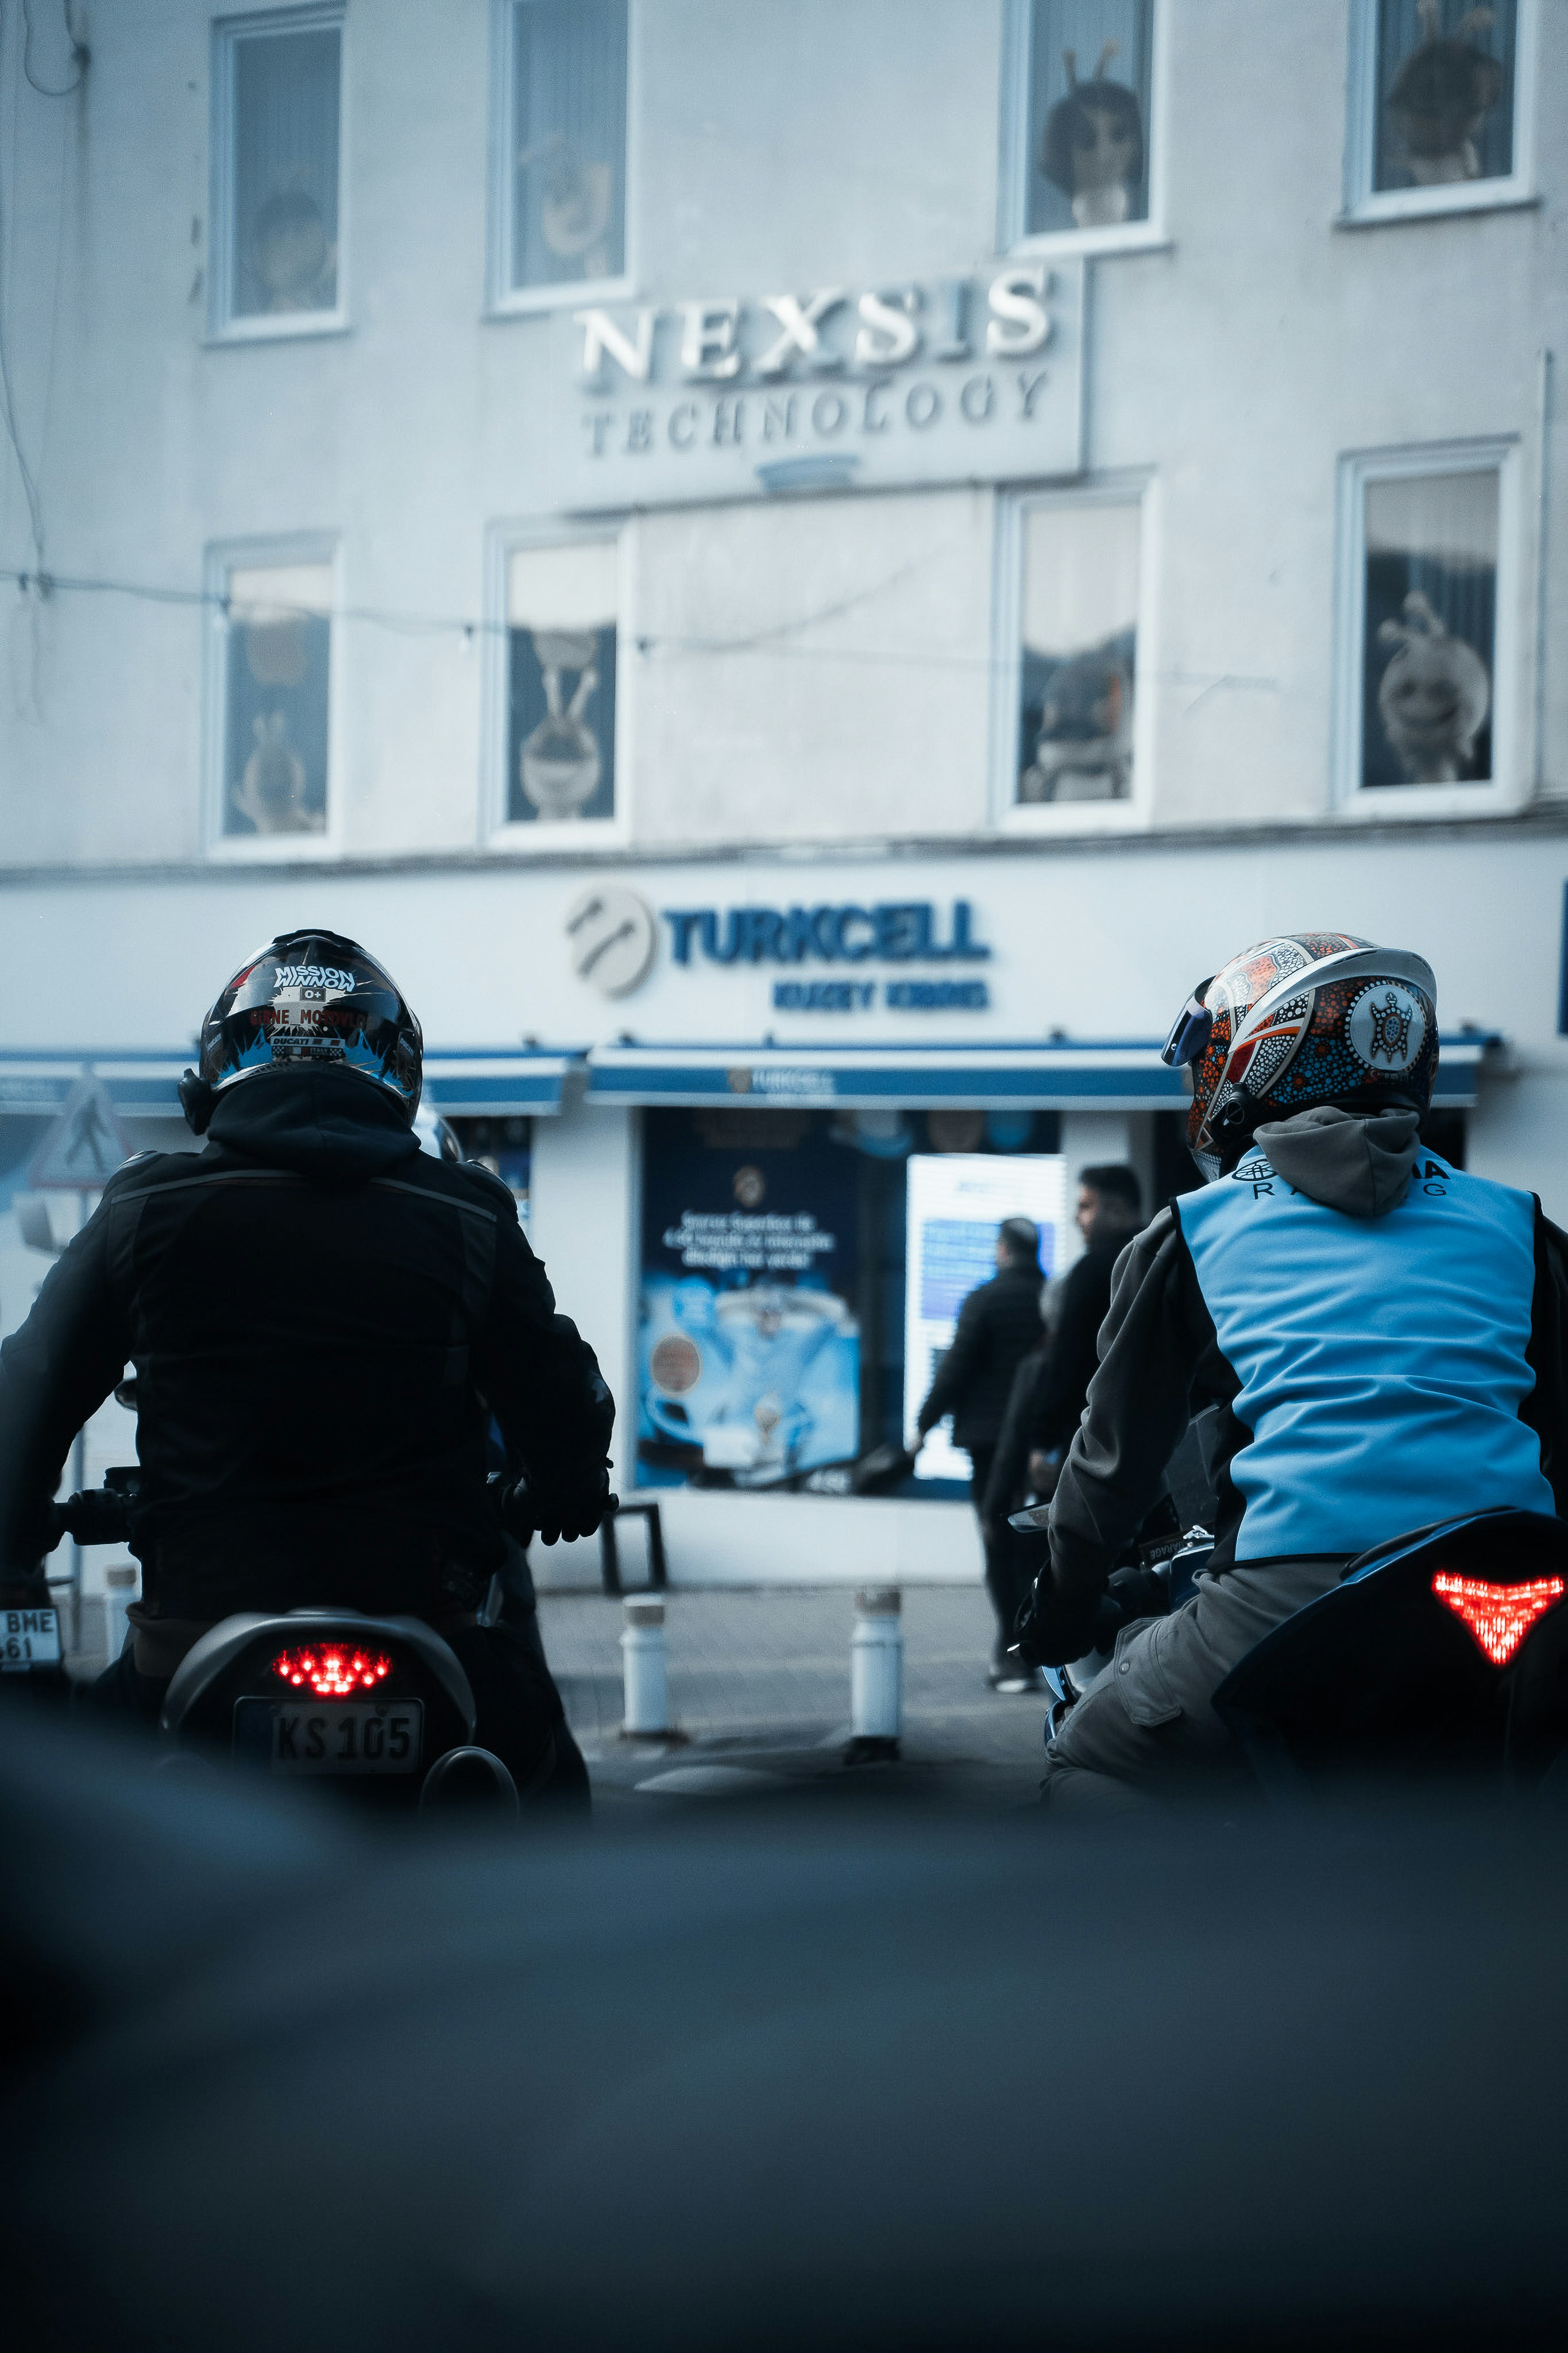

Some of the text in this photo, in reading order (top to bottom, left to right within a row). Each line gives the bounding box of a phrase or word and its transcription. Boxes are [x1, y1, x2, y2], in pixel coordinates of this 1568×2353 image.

[574, 266, 1056, 380] NEXSIS
[582, 371, 1048, 457] TECHNOLOGY
[662, 899, 992, 966] TURKCELL
[273, 975, 356, 992] WINNOW
[275, 966, 354, 982] MISSION
[7, 1612, 53, 1633] BME
[0, 1636, 32, 1658] 61
[279, 1718, 410, 1760] KS 105
